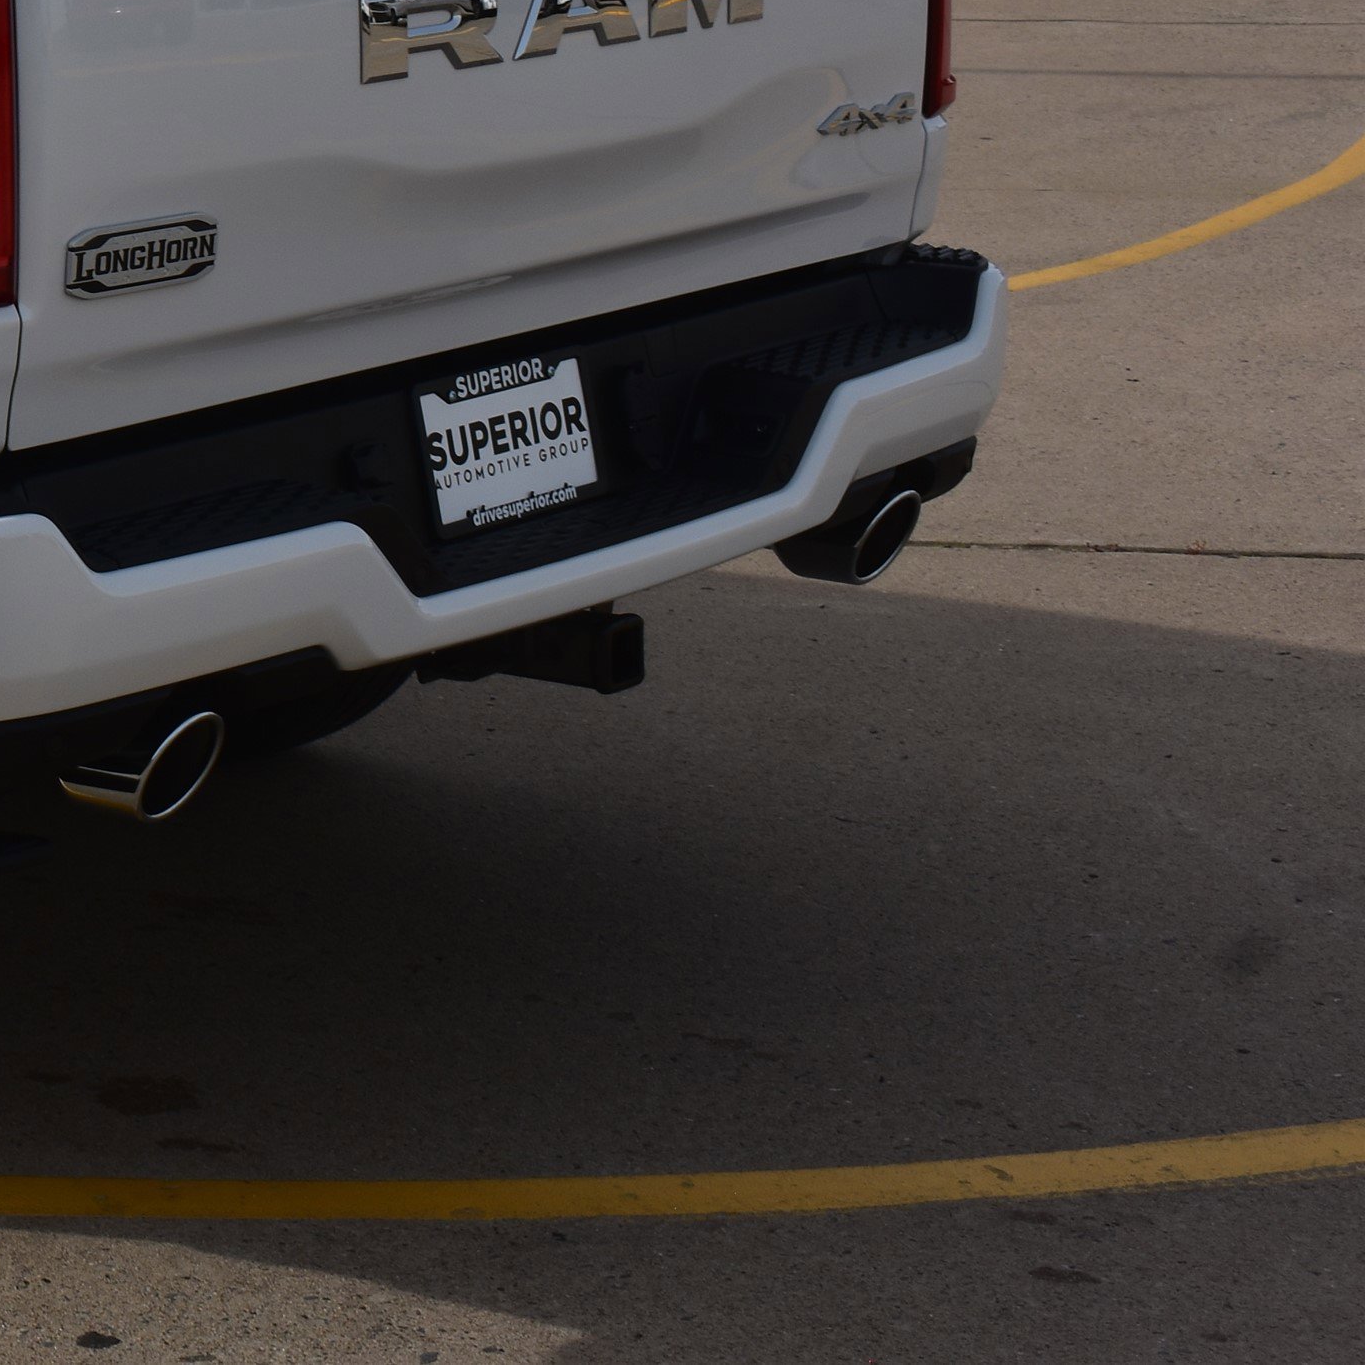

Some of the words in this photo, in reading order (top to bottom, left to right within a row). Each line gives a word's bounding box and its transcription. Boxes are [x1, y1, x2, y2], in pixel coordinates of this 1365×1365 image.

[455, 358, 544, 399] SUPERIOR
[426, 396, 586, 471] SUPERIOR
[434, 453, 532, 491] AUTOMOTIVE
[538, 438, 590, 462] GROUP
[472, 485, 578, 527] drivesuperior.com
